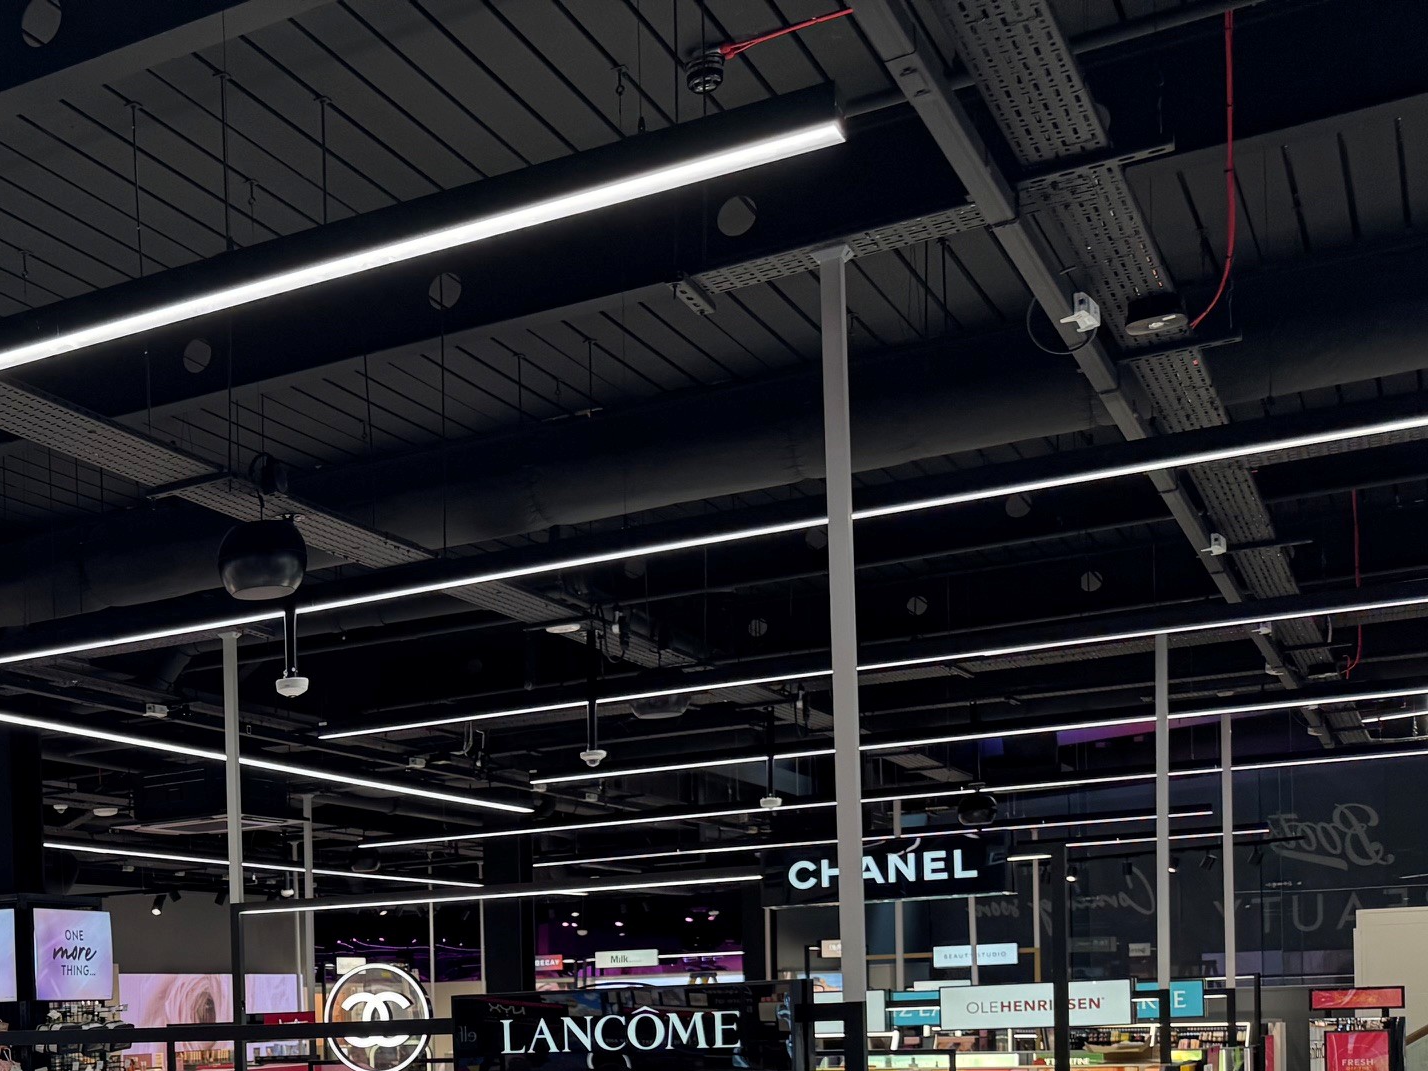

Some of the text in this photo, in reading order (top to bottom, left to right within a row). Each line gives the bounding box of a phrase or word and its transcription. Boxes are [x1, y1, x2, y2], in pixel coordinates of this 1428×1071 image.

[788, 848, 978, 891] CHANEL
[64, 929, 84, 942] ONE
[52, 943, 97, 962] more
[60, 964, 96, 977] THING...
[966, 997, 1101, 1015] OLEHENRISEN
[501, 1006, 741, 1054] LANCÔME
[1341, 1058, 1374, 1066] FRESH
